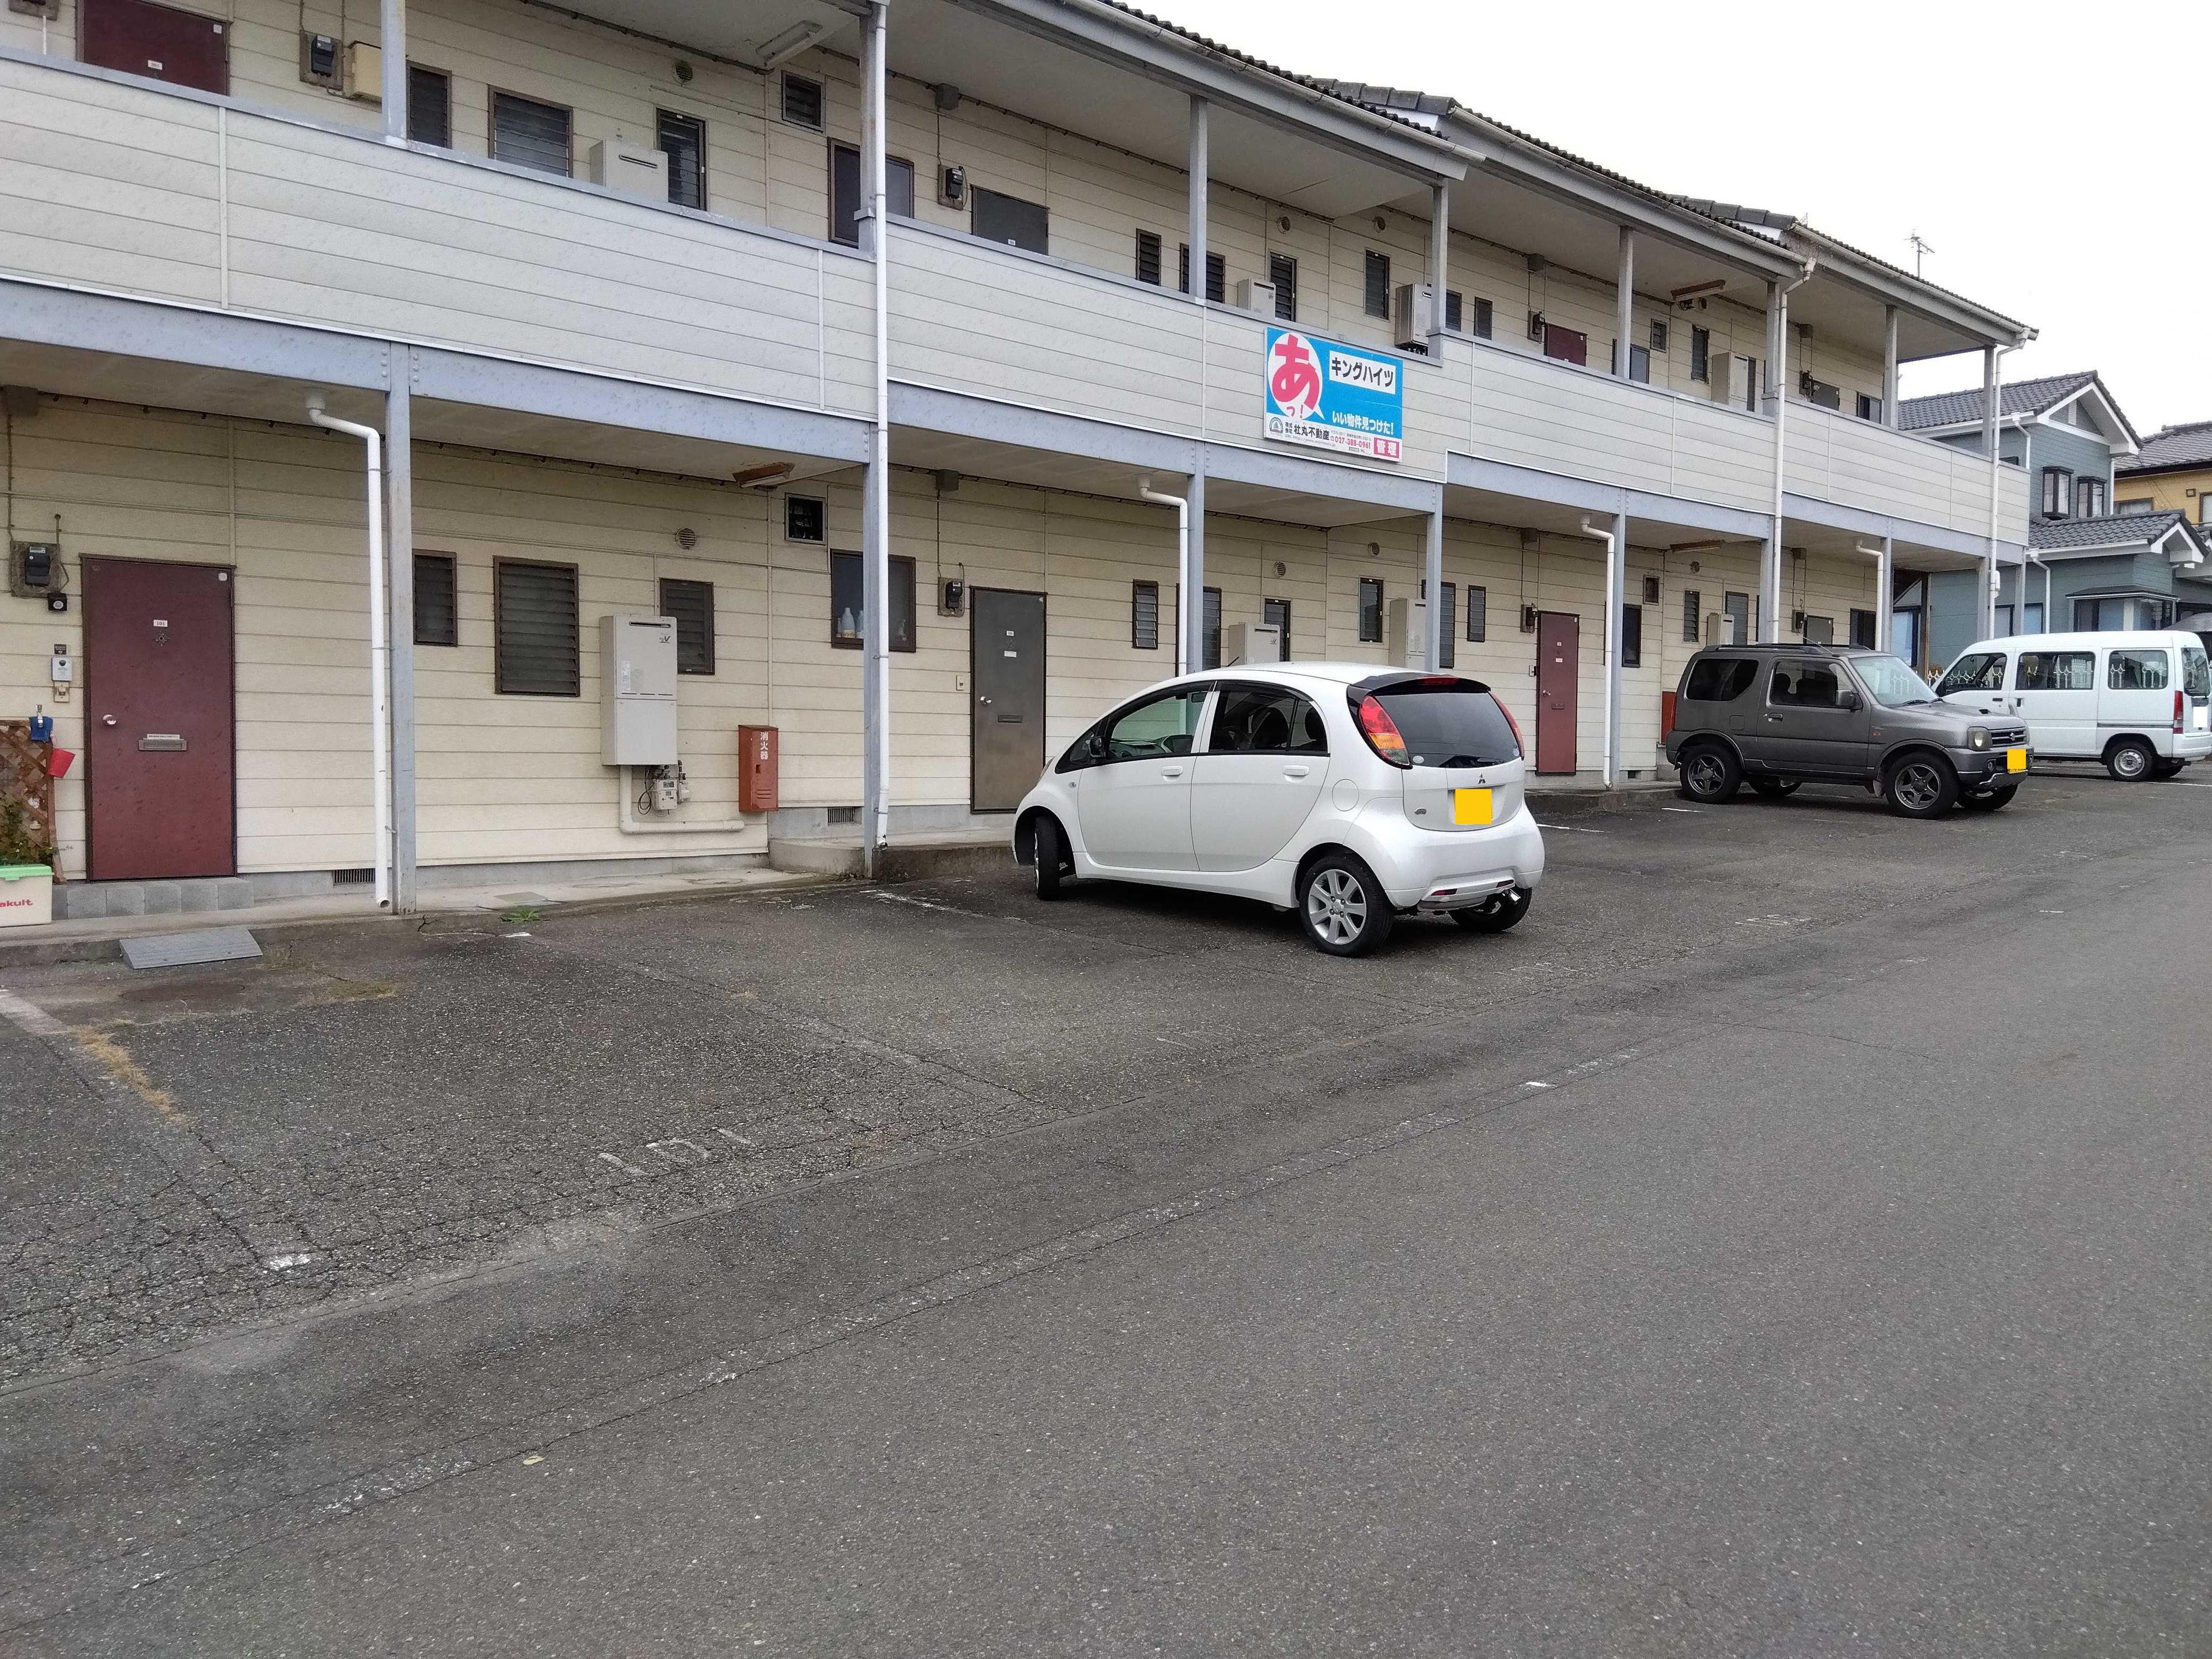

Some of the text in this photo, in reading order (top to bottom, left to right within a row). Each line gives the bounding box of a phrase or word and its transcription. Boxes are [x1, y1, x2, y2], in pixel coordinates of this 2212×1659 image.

[1331, 357, 1393, 388] キングハイツ
[1332, 411, 1393, 435] いい物件見つけた!
[1377, 439, 1397, 456] 管理
[760, 732, 768, 760] 消火器
